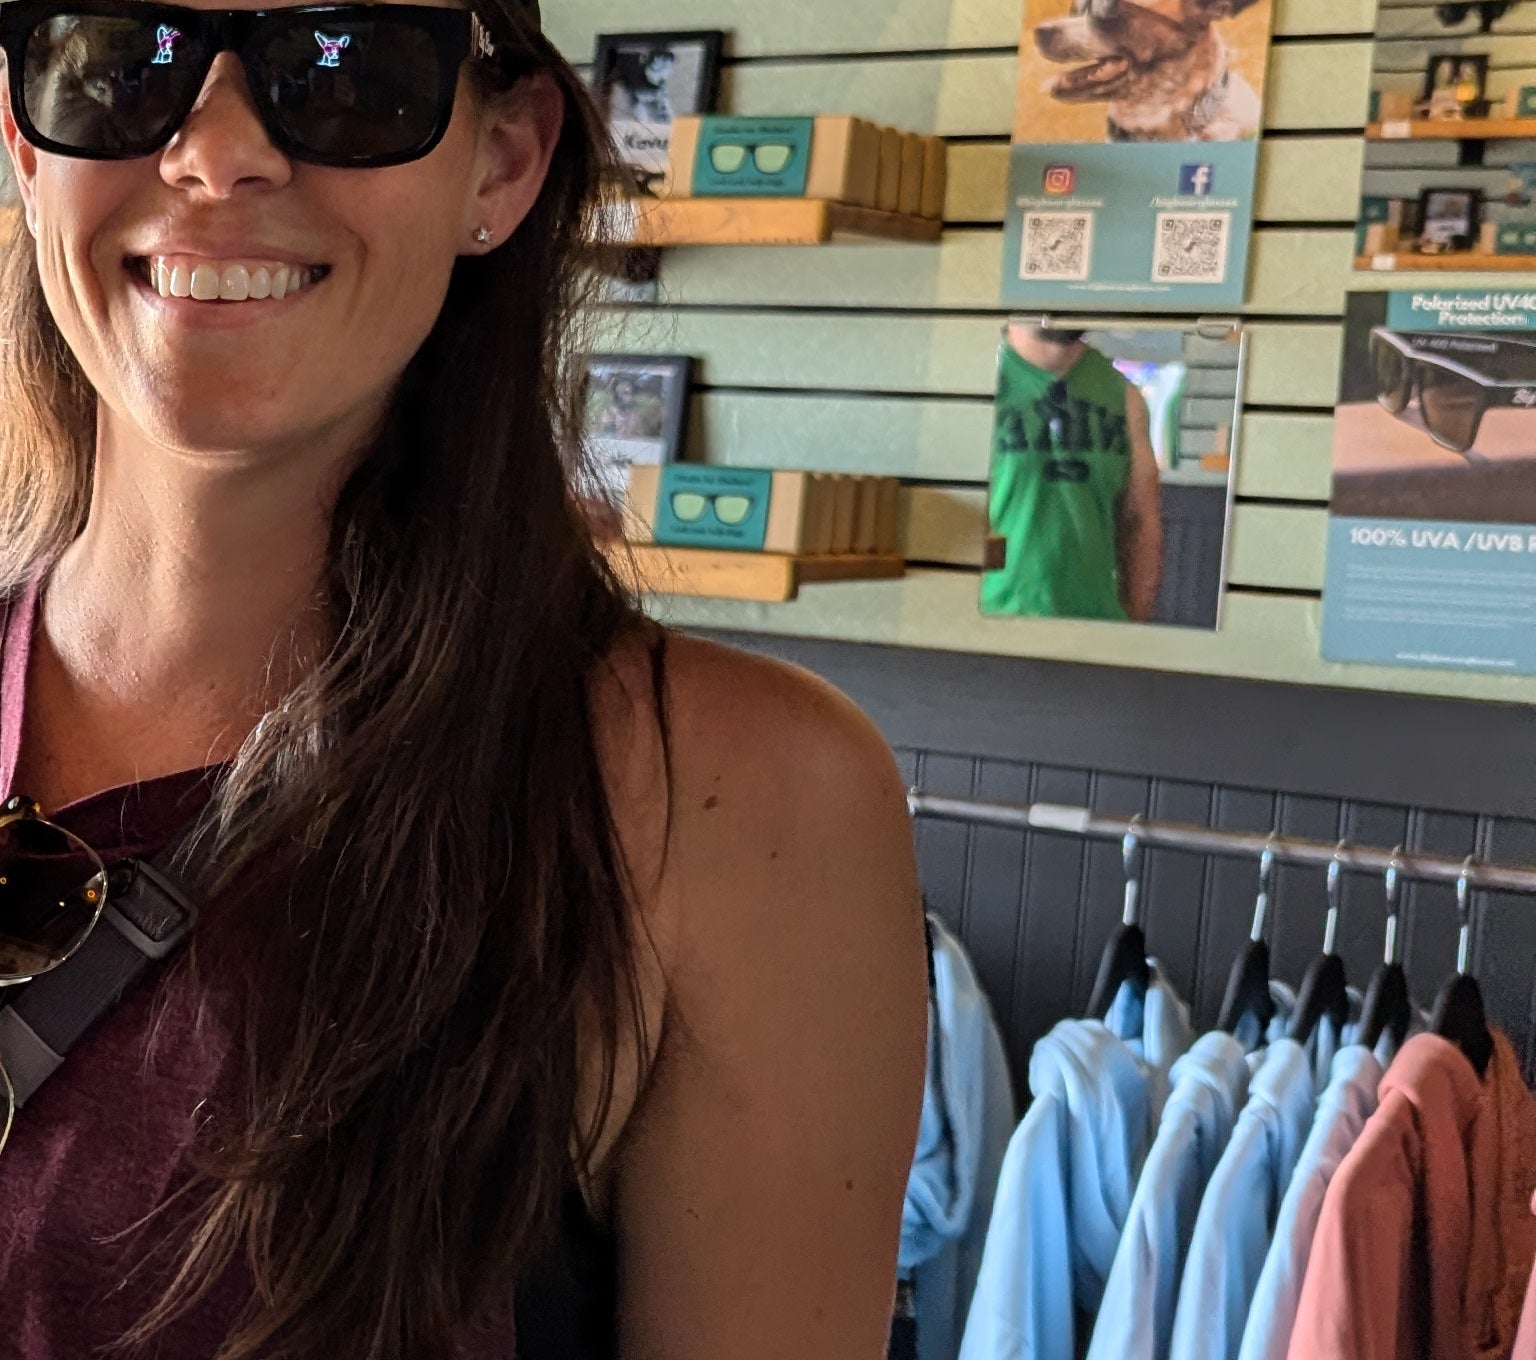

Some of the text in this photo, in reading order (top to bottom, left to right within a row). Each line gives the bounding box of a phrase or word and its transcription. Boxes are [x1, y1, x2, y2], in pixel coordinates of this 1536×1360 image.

[1411, 294, 1490, 311] Polarized
[1438, 311, 1529, 326] Protection
[1350, 528, 1406, 547] 100%
[1412, 529, 1460, 550] UVA
[1463, 532, 1524, 552] /UVB
